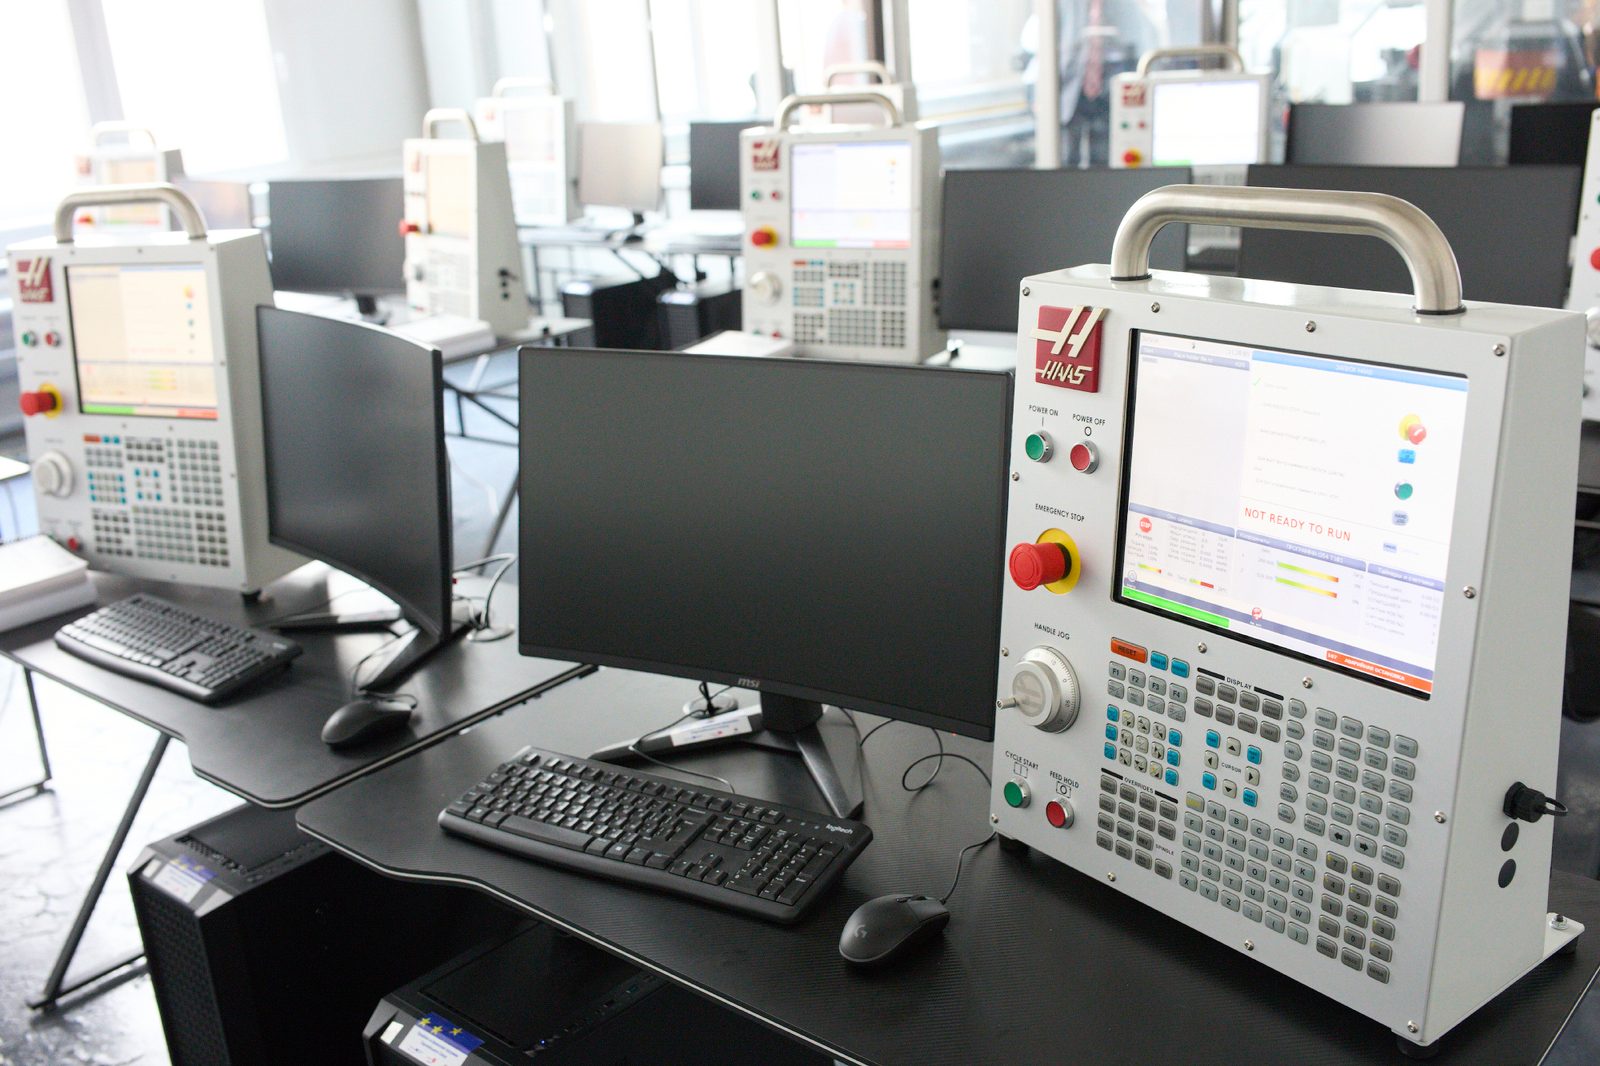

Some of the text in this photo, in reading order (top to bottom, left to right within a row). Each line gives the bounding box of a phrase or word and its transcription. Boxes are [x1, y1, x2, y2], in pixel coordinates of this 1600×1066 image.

[1035, 360, 1093, 385] HAAS
[1029, 405, 1059, 416] POWER ON
[1072, 413, 1106, 426] POWER OFF
[1035, 503, 1085, 522] EMERGENCY STOP
[1245, 507, 1351, 541] NOT READY TO RUN
[1034, 622, 1070, 640] HANDLE JOG
[1117, 646, 1136, 656] RESET
[1112, 668, 1119, 676] F1
[738, 678, 760, 688] msi
[1132, 675, 1139, 683] F2
[1226, 677, 1251, 690] DISPLAY
[1152, 682, 1159, 690] F3
[1172, 690, 1180, 698] F4
[1005, 750, 1039, 770] CYCLE START
[1221, 762, 1241, 773] CURSOR
[1050, 770, 1080, 789] FEED HOLD
[1124, 777, 1153, 793] OVERRIDES
[826, 824, 853, 834] logitech
[1303, 846, 1308, 854] E
[1185, 858, 1191, 866] R
[1207, 868, 1212, 876] S
[1252, 868, 1258, 876] O
[1300, 867, 1306, 876] K
[1274, 878, 1280, 886] P
[1250, 888, 1256, 896] U
[1226, 898, 1231, 906] Z
[1295, 909, 1302, 918] W
[1350, 935, 1356, 943] 0
